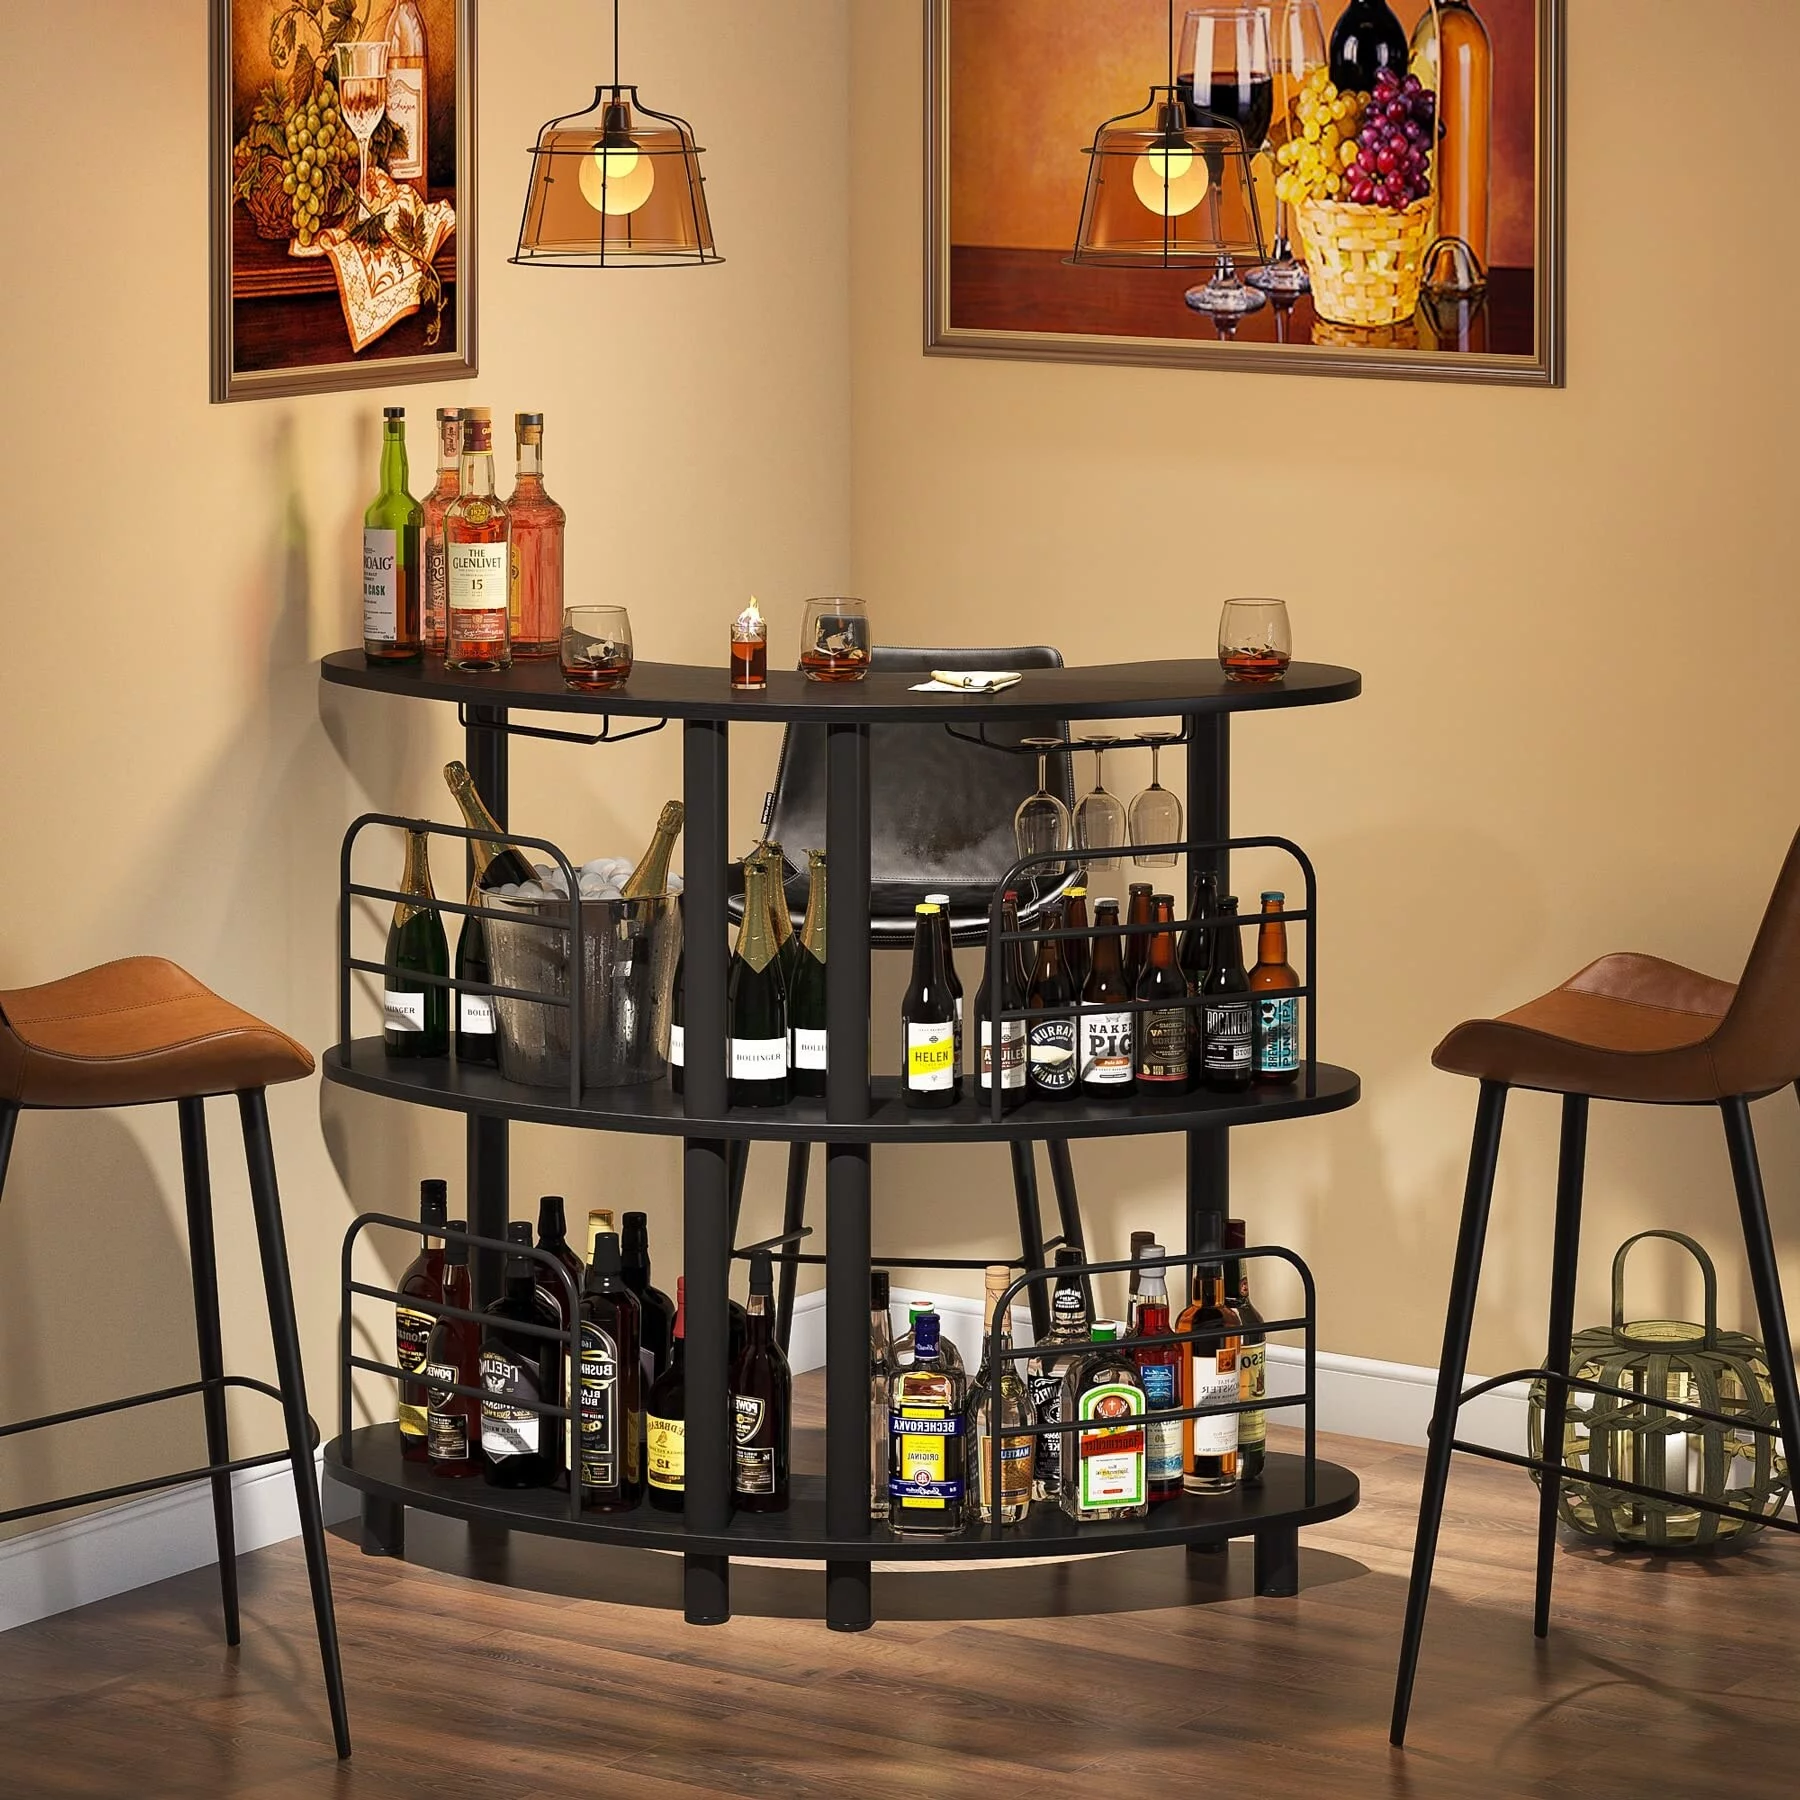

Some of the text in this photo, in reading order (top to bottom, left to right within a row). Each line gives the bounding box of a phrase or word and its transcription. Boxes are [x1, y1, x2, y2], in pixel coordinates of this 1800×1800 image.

[468, 549, 485, 558] THE
[452, 557, 501, 569] GLENLIVET
[368, 584, 386, 597] CASK
[471, 579, 483, 591] 15
[1089, 1022, 1133, 1033] NAKED
[1282, 1000, 1291, 1066] PUNK IPA
[801, 1043, 826, 1051] BOLLI
[1089, 1033, 1133, 1056] PIG
[1267, 1026, 1278, 1067] BREWDOG
[736, 1053, 781, 1062] BOLLINGER
[915, 1051, 949, 1062] HELEN
[984, 1047, 1024, 1061] AUILES
[1032, 1064, 1065, 1085] WHALE
